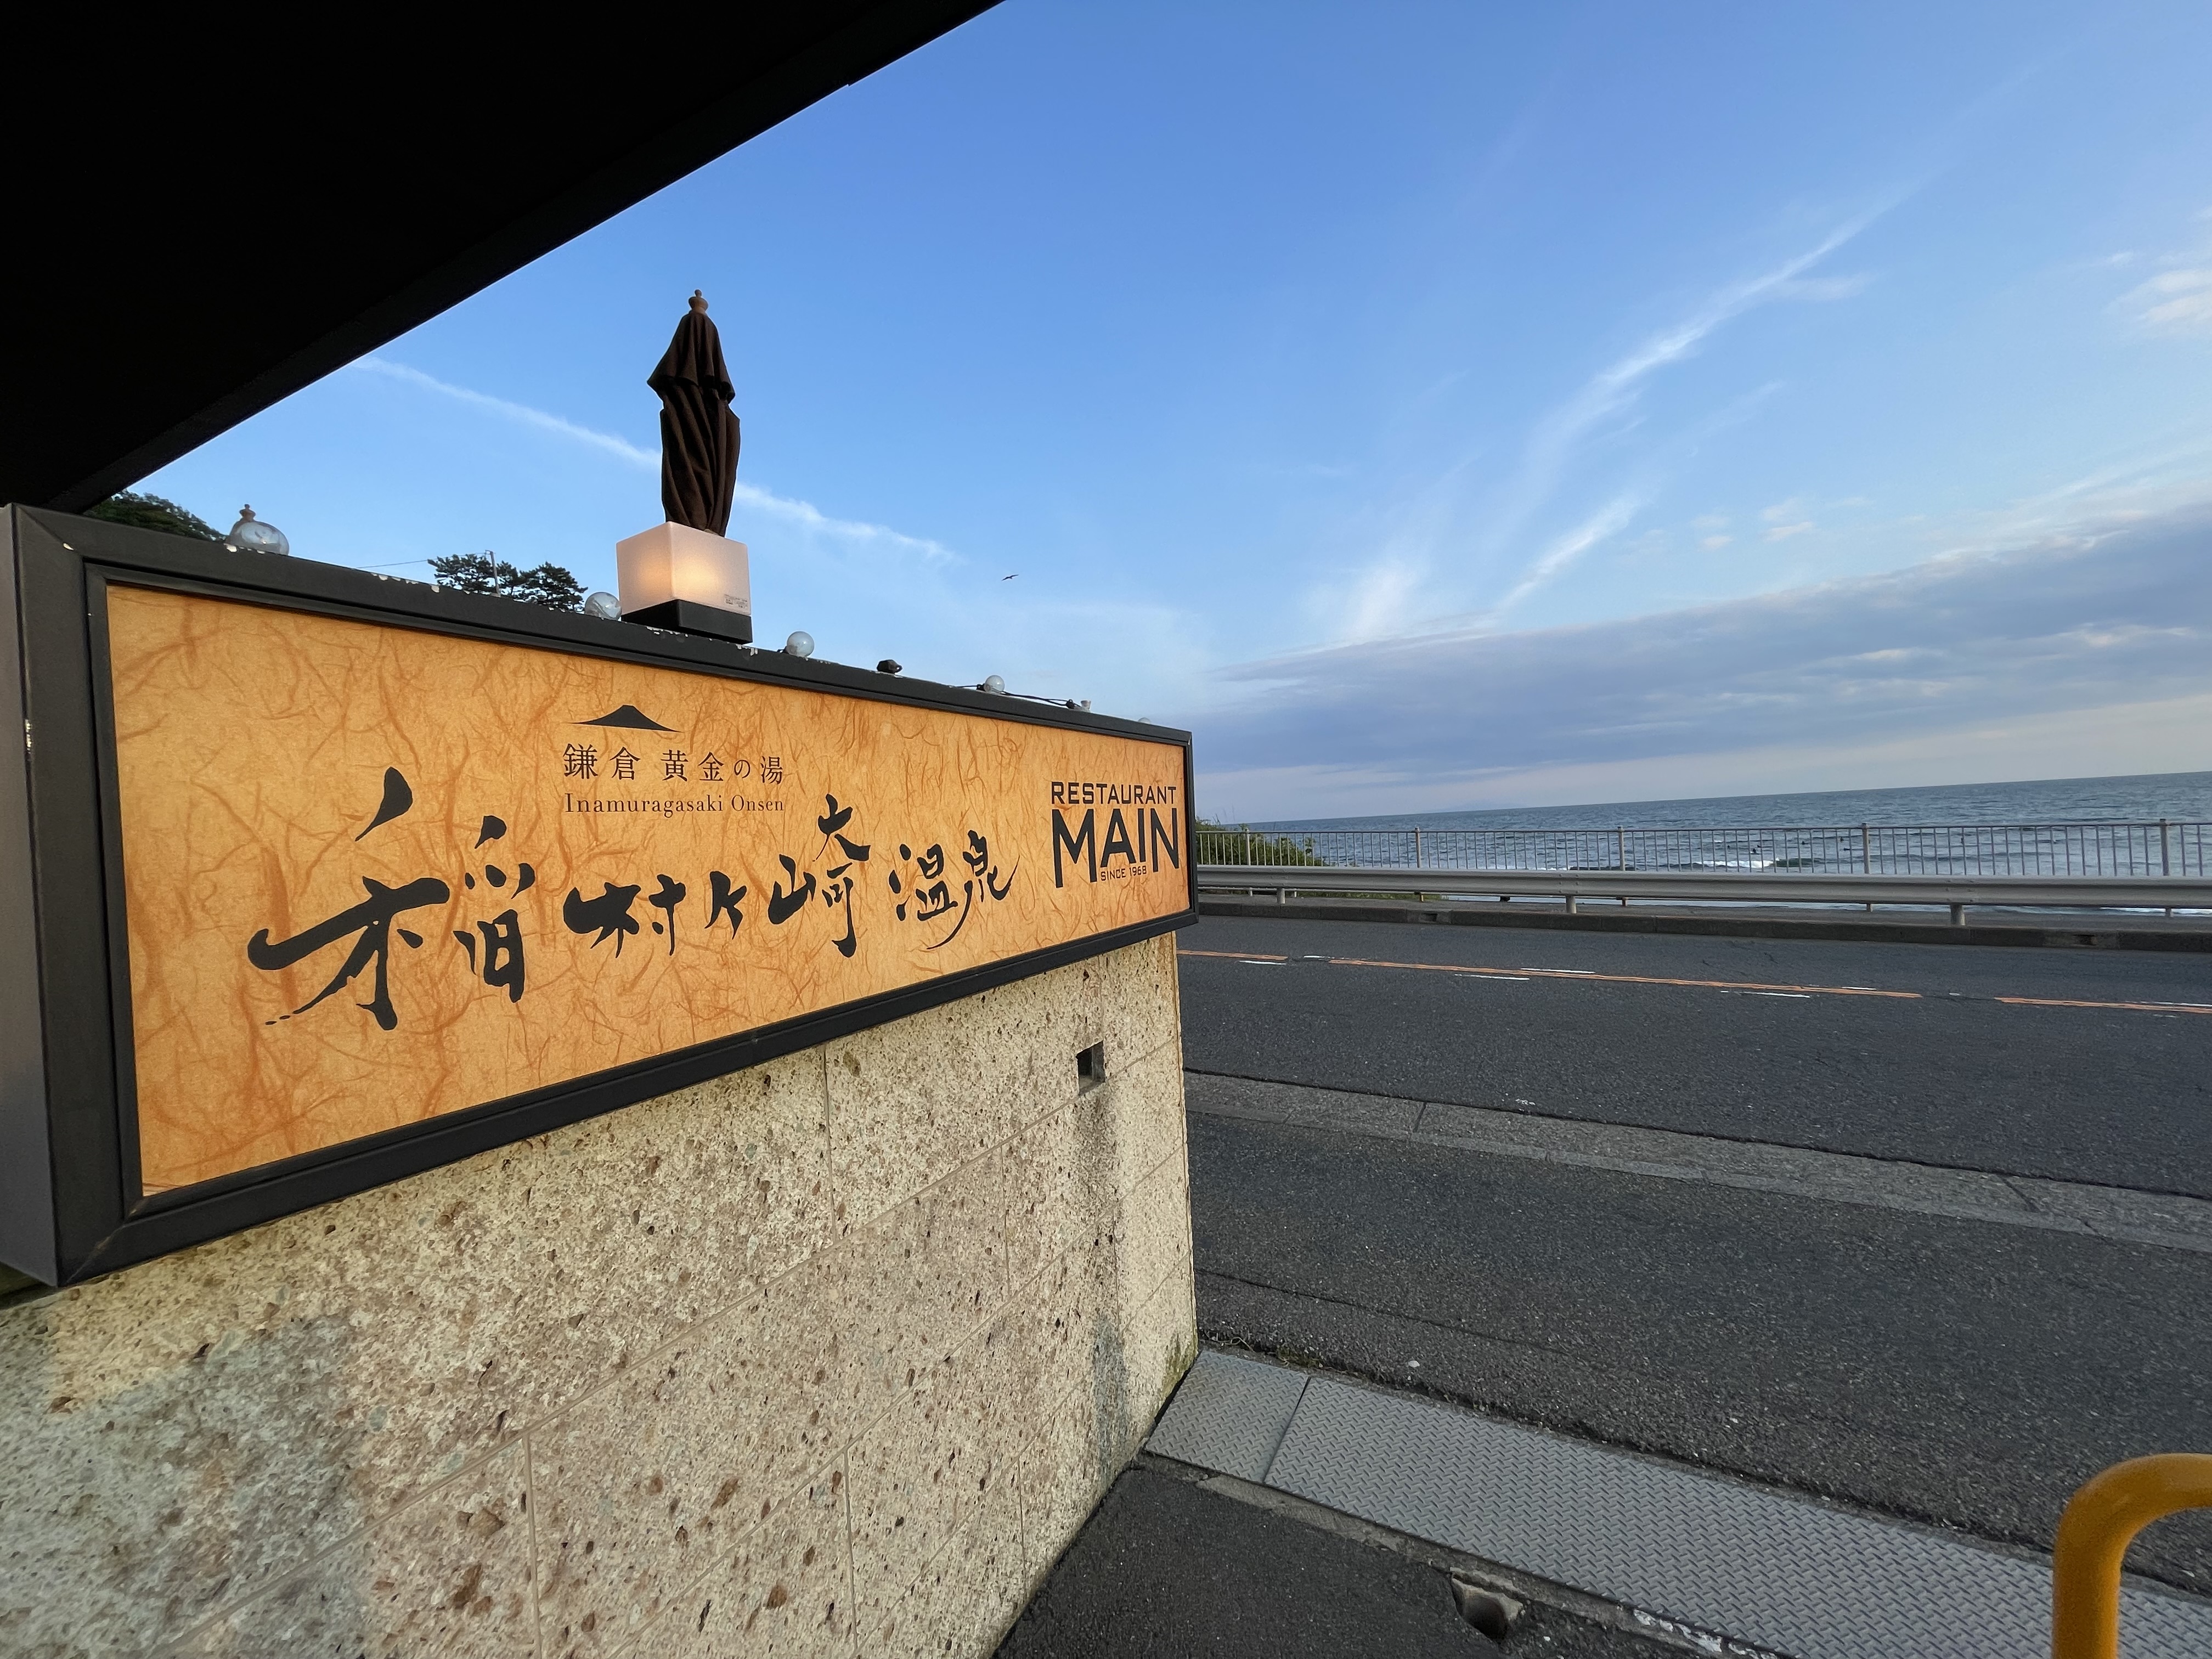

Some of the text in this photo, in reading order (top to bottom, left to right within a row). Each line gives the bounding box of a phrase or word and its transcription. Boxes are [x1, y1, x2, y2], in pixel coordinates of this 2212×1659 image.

[1052, 781, 1177, 804] RESTAURANT
[565, 793, 785, 818] Inamuragasaki Onsen
[1052, 808, 1180, 888] MAIN
[1101, 865, 1147, 881] SINCE 1968
